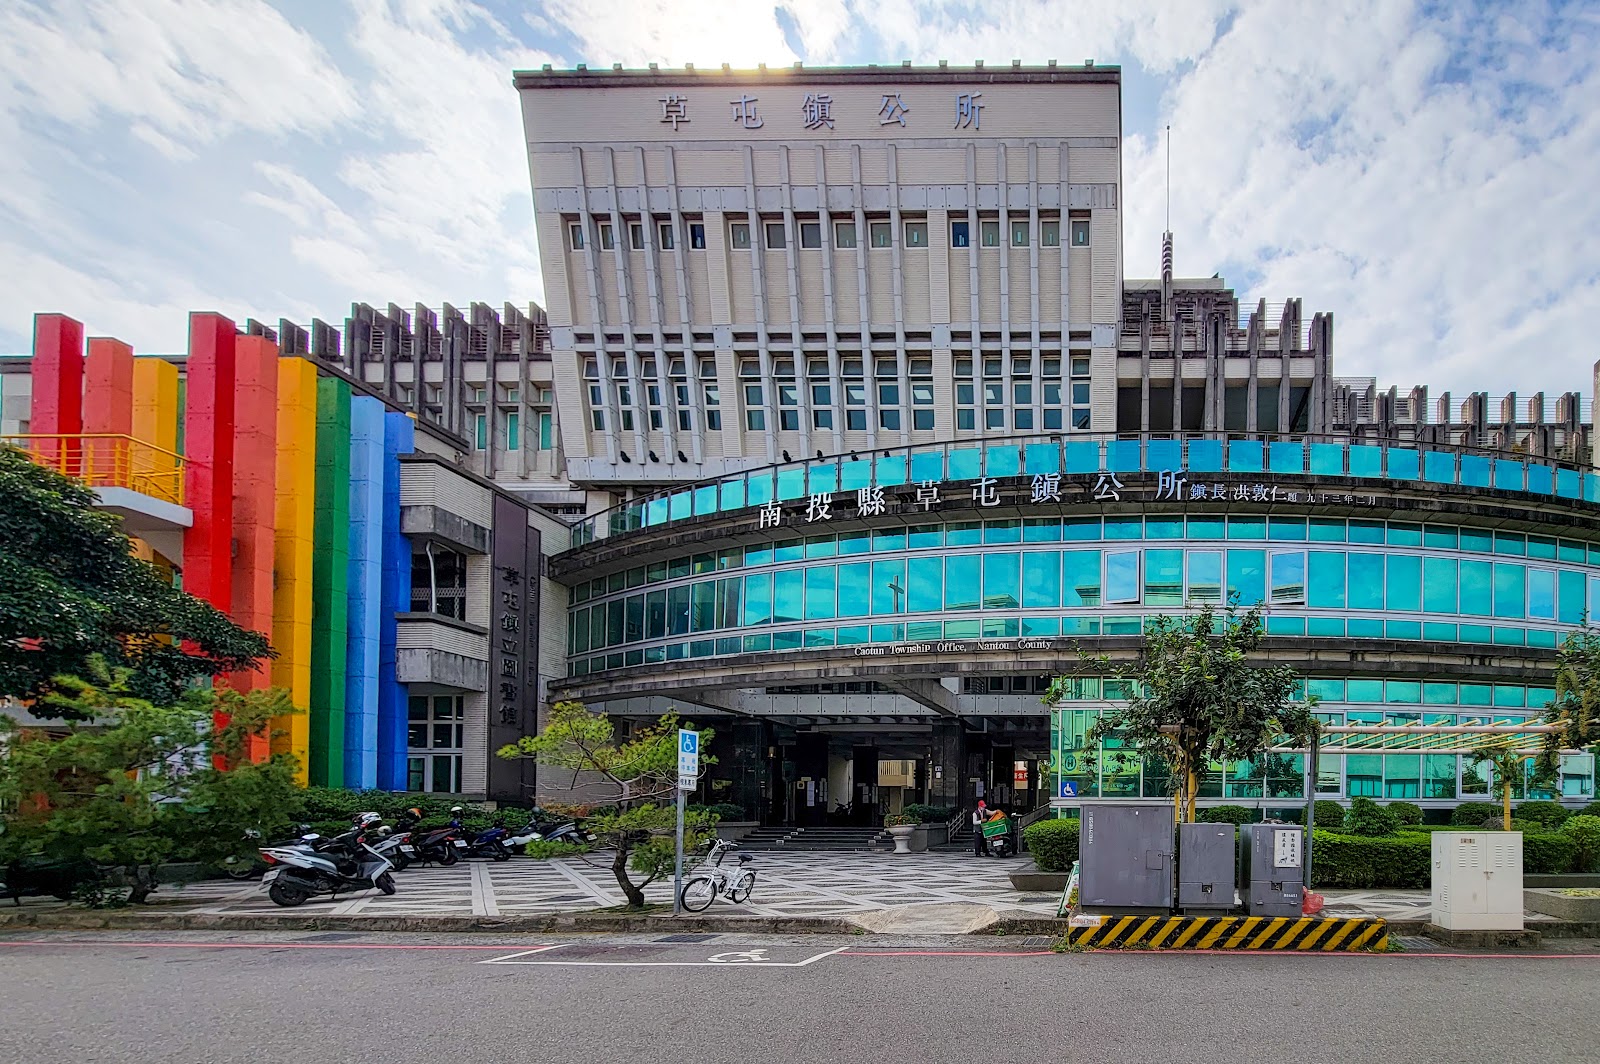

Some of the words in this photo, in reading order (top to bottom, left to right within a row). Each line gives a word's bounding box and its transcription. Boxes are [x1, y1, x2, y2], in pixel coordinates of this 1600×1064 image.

[658, 91, 985, 131] 草屯鎮公所
[758, 468, 1188, 528] 南投縣草屯鎮公所
[1306, 493, 1377, 506] 九十三年二月
[499, 566, 520, 725] 草屯鎮立圖書館
[854, 647, 885, 656] Caotun
[889, 643, 931, 654] Township
[937, 642, 967, 652] Office,
[977, 641, 1010, 650] Nantou
[1017, 639, 1053, 650] County
